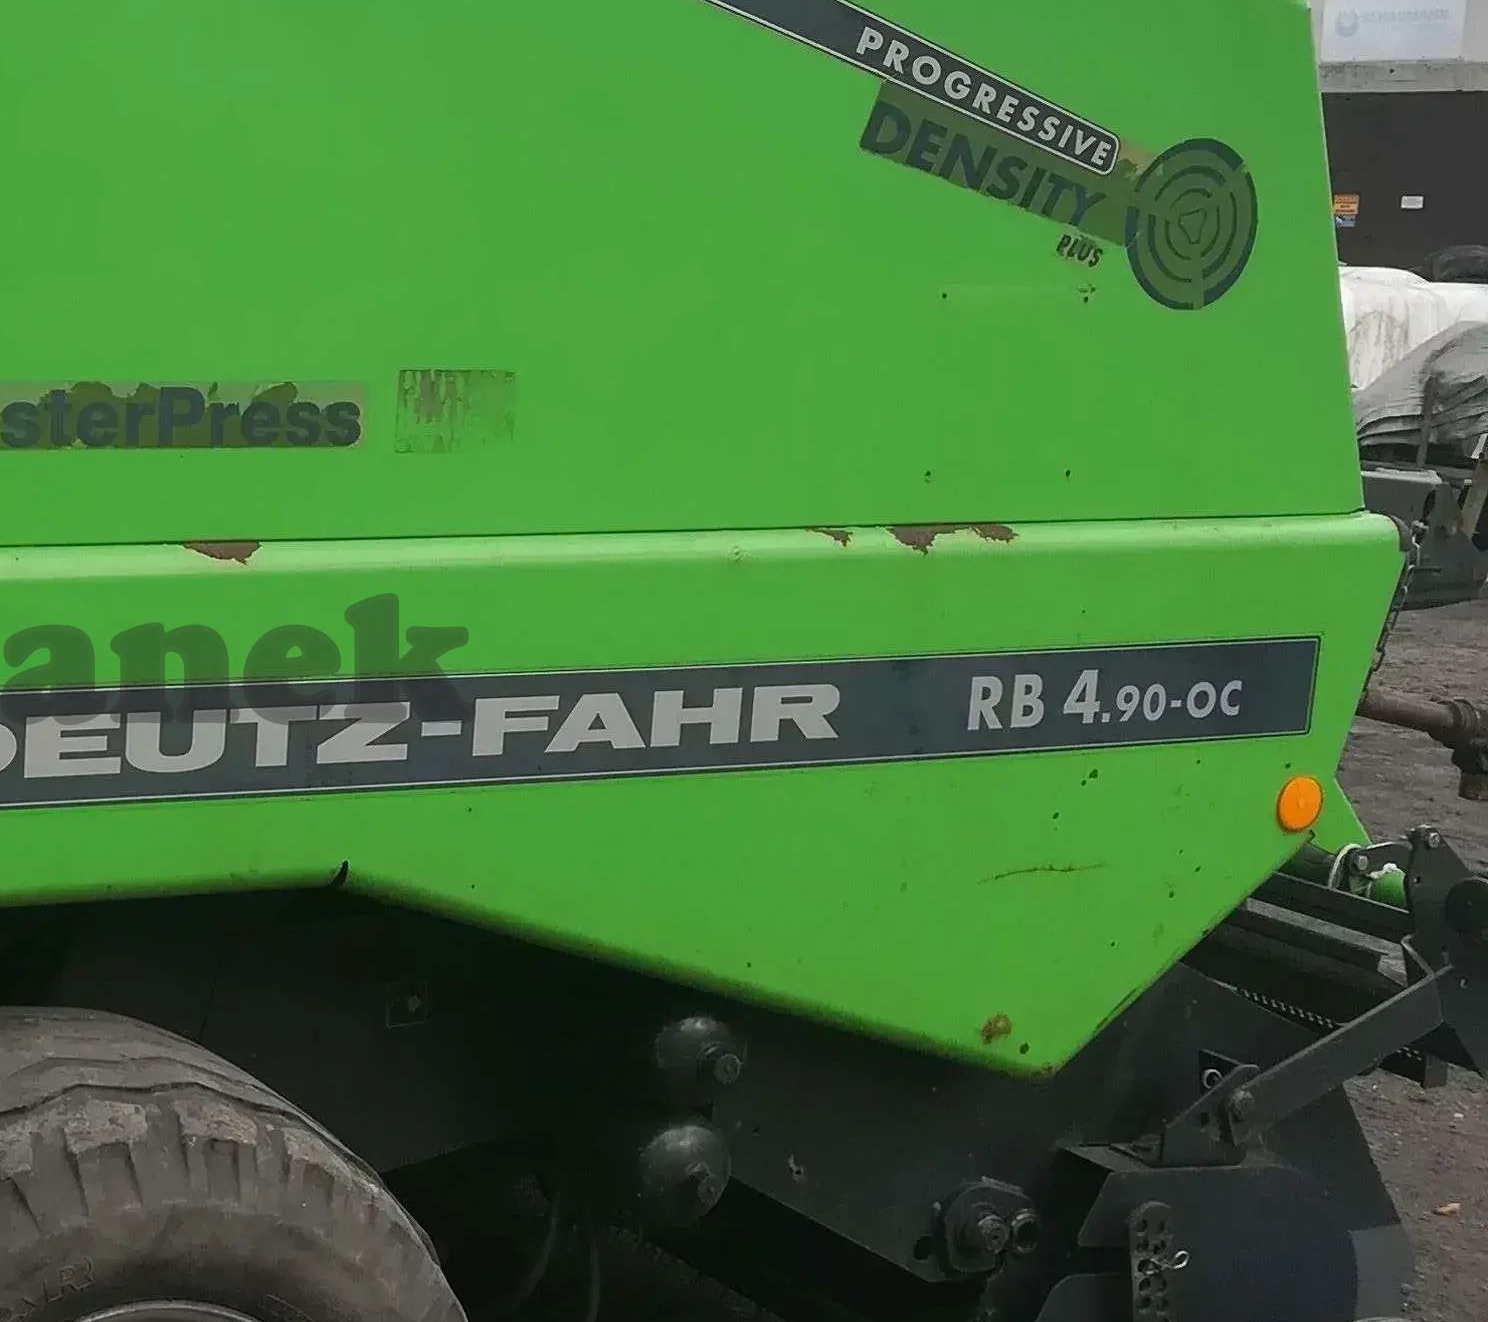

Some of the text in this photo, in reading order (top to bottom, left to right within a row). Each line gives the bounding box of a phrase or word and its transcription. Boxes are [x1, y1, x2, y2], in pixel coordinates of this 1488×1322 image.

[856, 26, 1112, 166] PROGRESSIVE
[859, 99, 1107, 227] DENSITY
[1055, 233, 1104, 268] PLUS
[967, 668, 1243, 731] RB 4.90-OC
